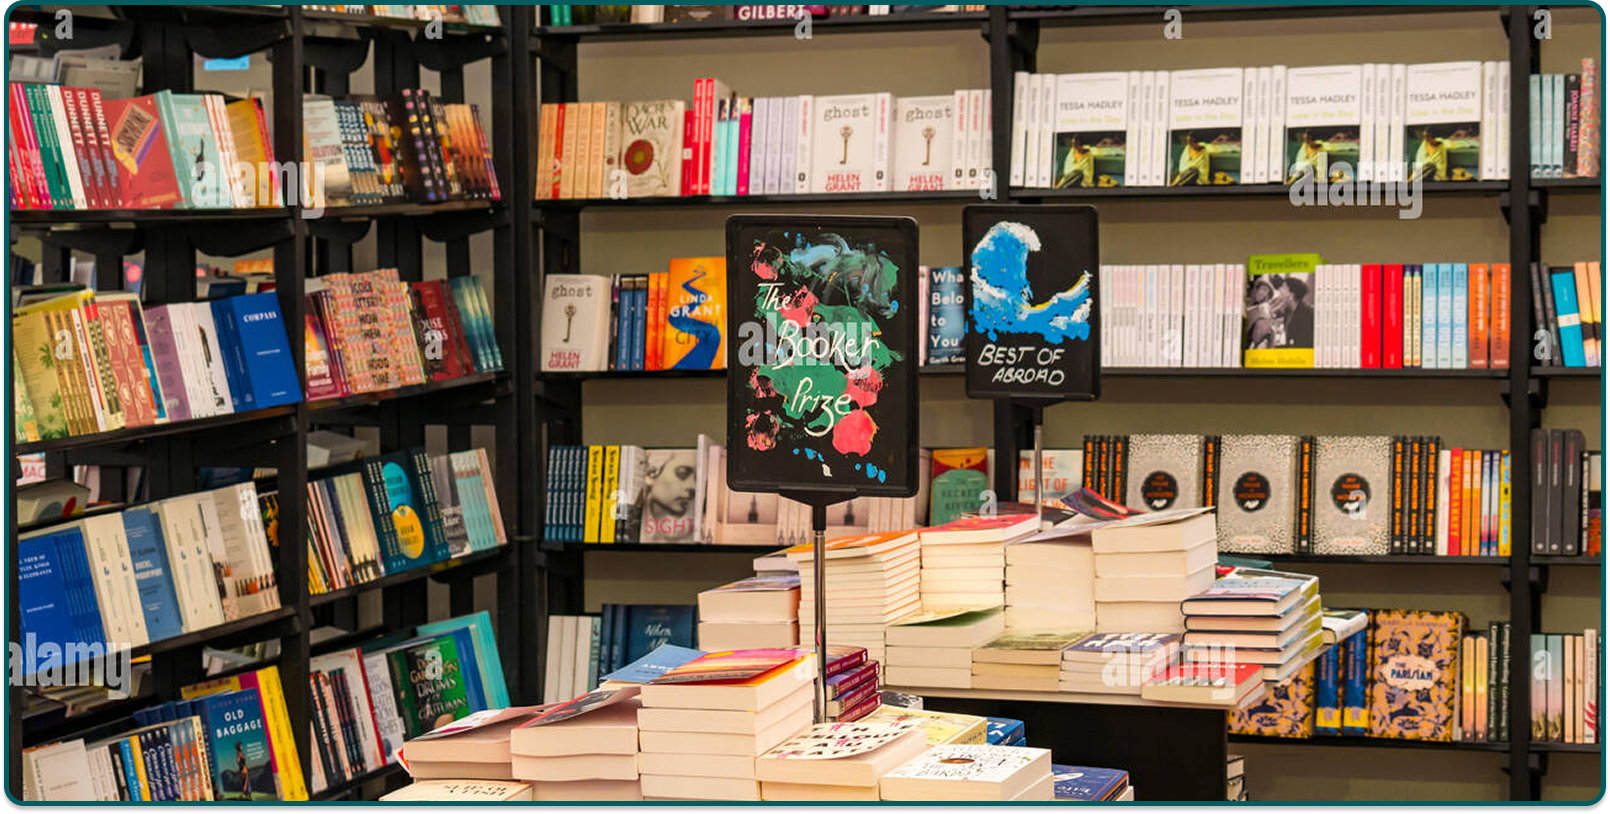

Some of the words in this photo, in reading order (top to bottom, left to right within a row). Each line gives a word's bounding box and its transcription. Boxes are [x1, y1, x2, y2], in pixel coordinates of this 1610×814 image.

[738, 6, 804, 20] GILBERT
[63, 90, 84, 145] DUNNETT
[77, 91, 97, 145] DUNNETT
[91, 92, 111, 145] DUNNETT
[823, 104, 869, 122] ghost
[906, 105, 952, 123] ghost
[627, 114, 668, 135] WAR
[827, 173, 860, 183] HELEN
[910, 174, 943, 184] HELEN
[825, 182, 861, 192] GRANT
[1255, 257, 1309, 270] Travellers
[932, 270, 964, 283] Wha
[552, 285, 593, 300] ghost
[680, 293, 713, 305] LINDA
[757, 282, 793, 311] The
[931, 291, 964, 306] Belo
[243, 311, 277, 323] COMPASS
[670, 304, 722, 318] GRANT
[931, 315, 946, 327] to
[772, 319, 880, 373] Booker
[931, 334, 959, 347] You
[551, 350, 580, 361] HELEN
[978, 344, 1036, 366] BEST
[1037, 348, 1065, 366] OF
[548, 360, 580, 369] GRANT
[992, 367, 1065, 386] ABROAD
[790, 376, 853, 438] Prize
[1018, 478, 1050, 491] LIGT
[1053, 478, 1068, 491] OF
[644, 517, 693, 535] SIGHT
[645, 622, 673, 638] When
[1390, 668, 1433, 681] PARISIAN
[224, 709, 244, 722] OLD
[216, 718, 262, 739] BAGGAGE
